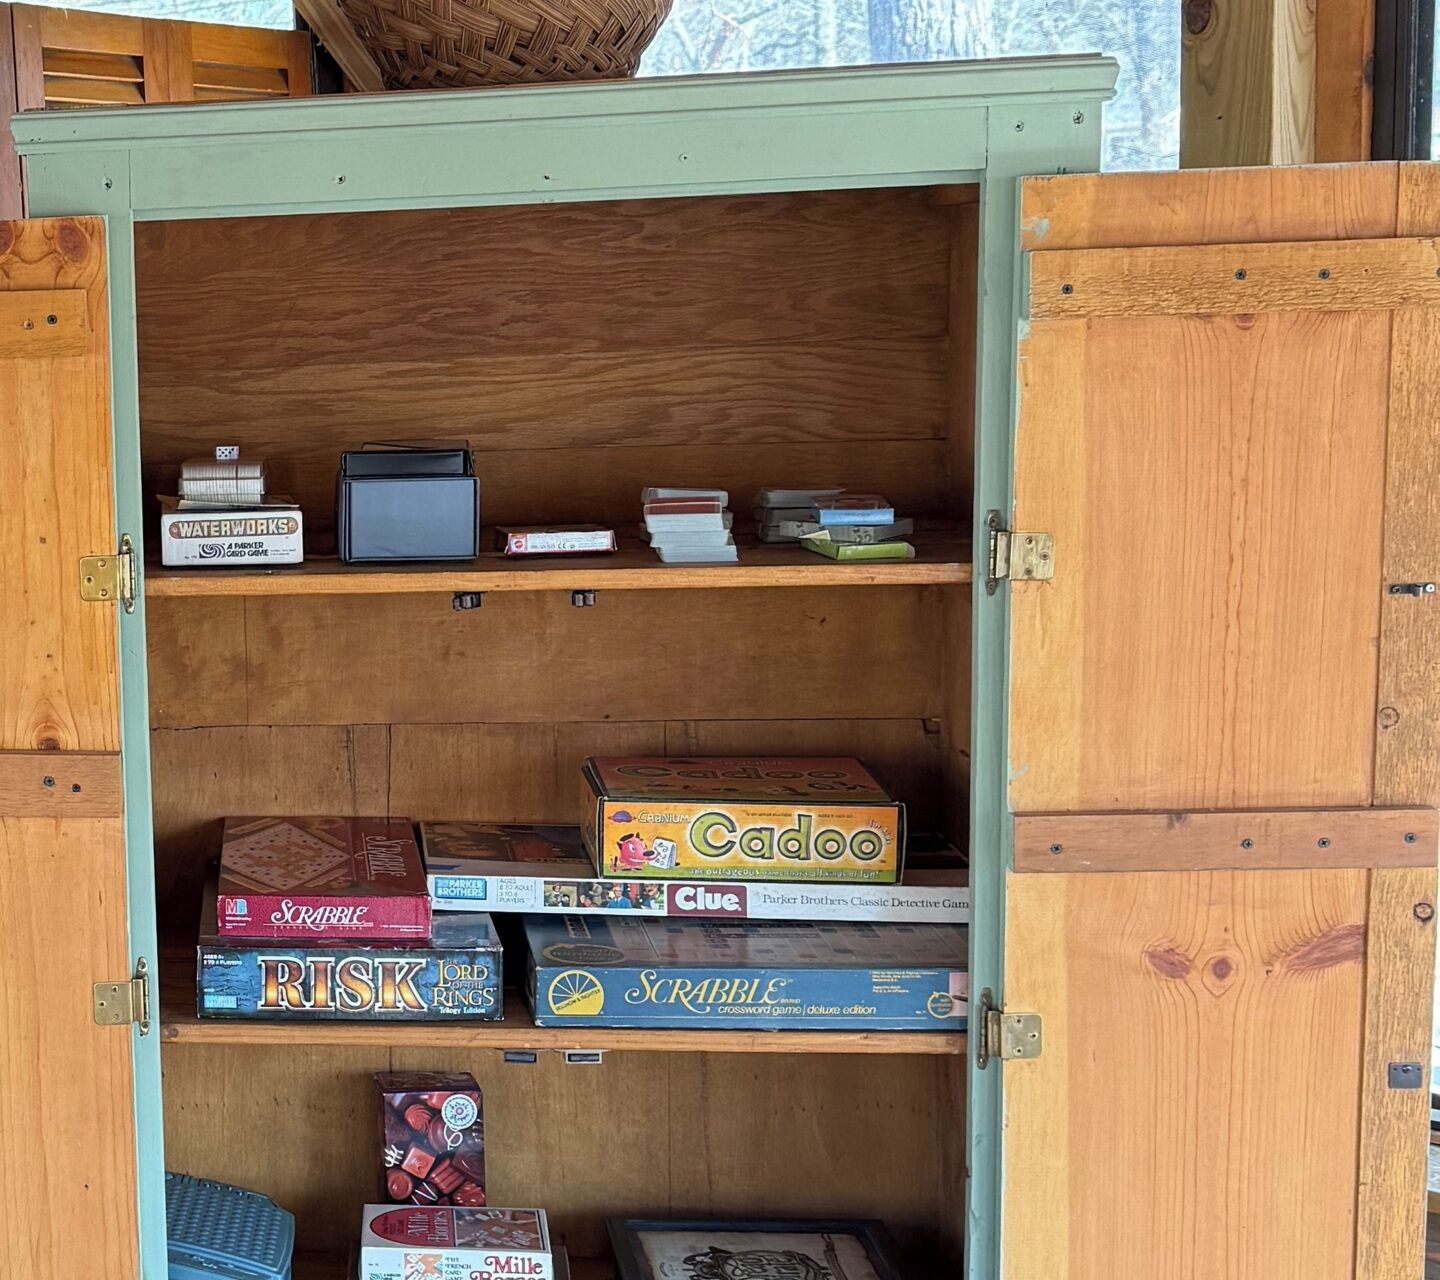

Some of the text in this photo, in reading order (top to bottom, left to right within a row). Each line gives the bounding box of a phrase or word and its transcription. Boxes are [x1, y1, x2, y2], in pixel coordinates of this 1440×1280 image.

[179, 519, 288, 538] WATERWORKS
[226, 550, 246, 558] CARD
[247, 549, 269, 557] GAME
[234, 541, 264, 550] PARKER
[689, 811, 883, 861] Cadoo
[706, 868, 760, 878] outrageous
[449, 879, 483, 888] PARKER
[437, 887, 484, 897] BROTHERS
[674, 887, 740, 912] Clue
[225, 899, 247, 915] MB
[763, 893, 969, 909] Parker Brothers Classic Detective Gam
[271, 900, 369, 930] SCRABBLE
[437, 959, 488, 987] LORD
[257, 955, 428, 1013] RISK
[465, 981, 484, 989] THE
[624, 969, 787, 1014] SCRABBLE
[432, 987, 495, 1007] RINGS
[440, 1006, 461, 1015] Trilogy
[718, 1005, 876, 1016] crossword game deluxe edition
[484, 1255, 543, 1274] Mille
